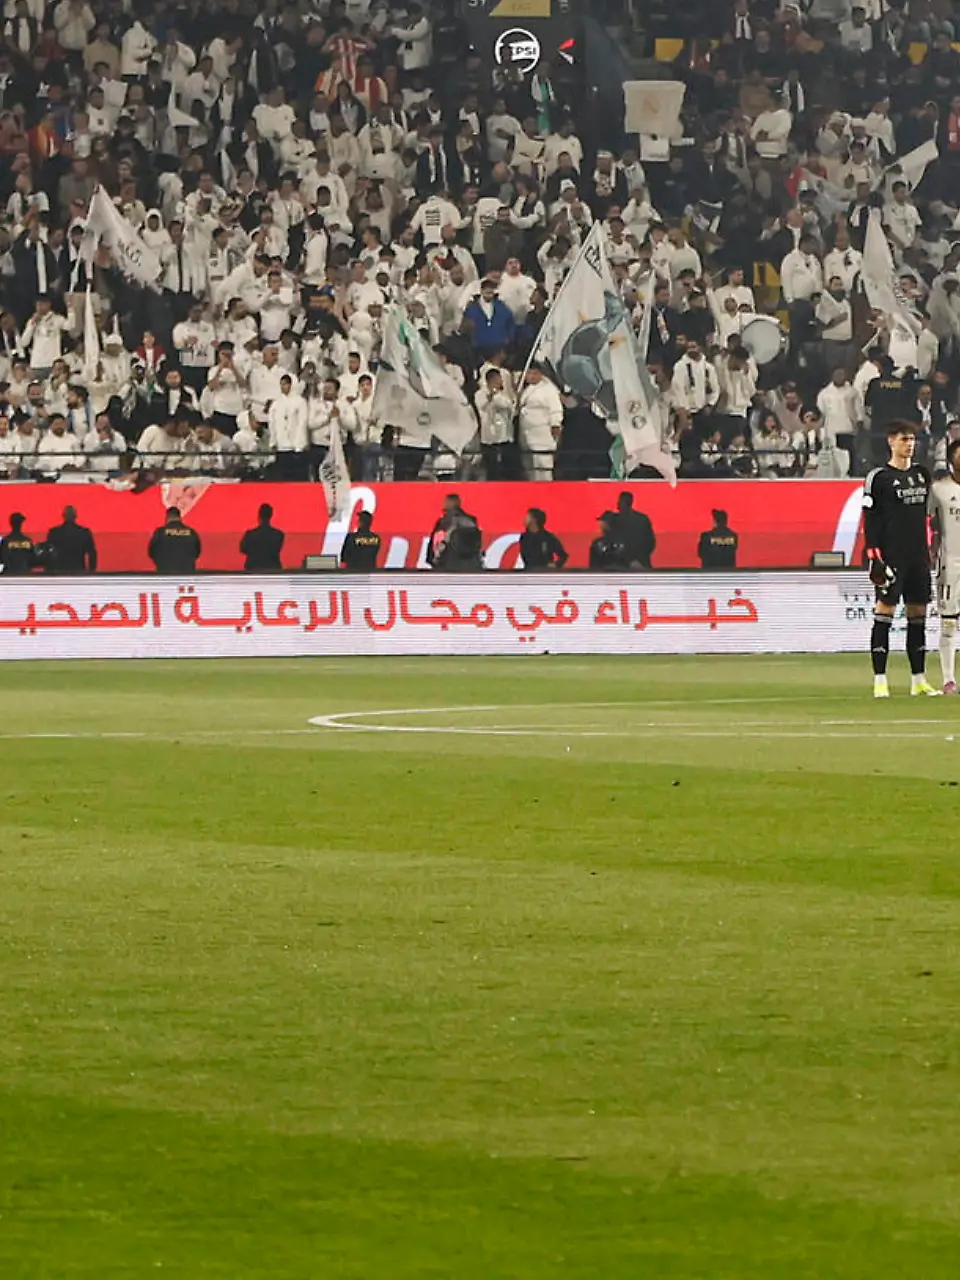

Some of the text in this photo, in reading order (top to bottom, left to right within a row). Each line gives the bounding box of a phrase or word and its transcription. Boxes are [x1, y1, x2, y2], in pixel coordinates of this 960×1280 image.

[0, 586, 759, 643] خبراء في مجال الرعاية الصحي
